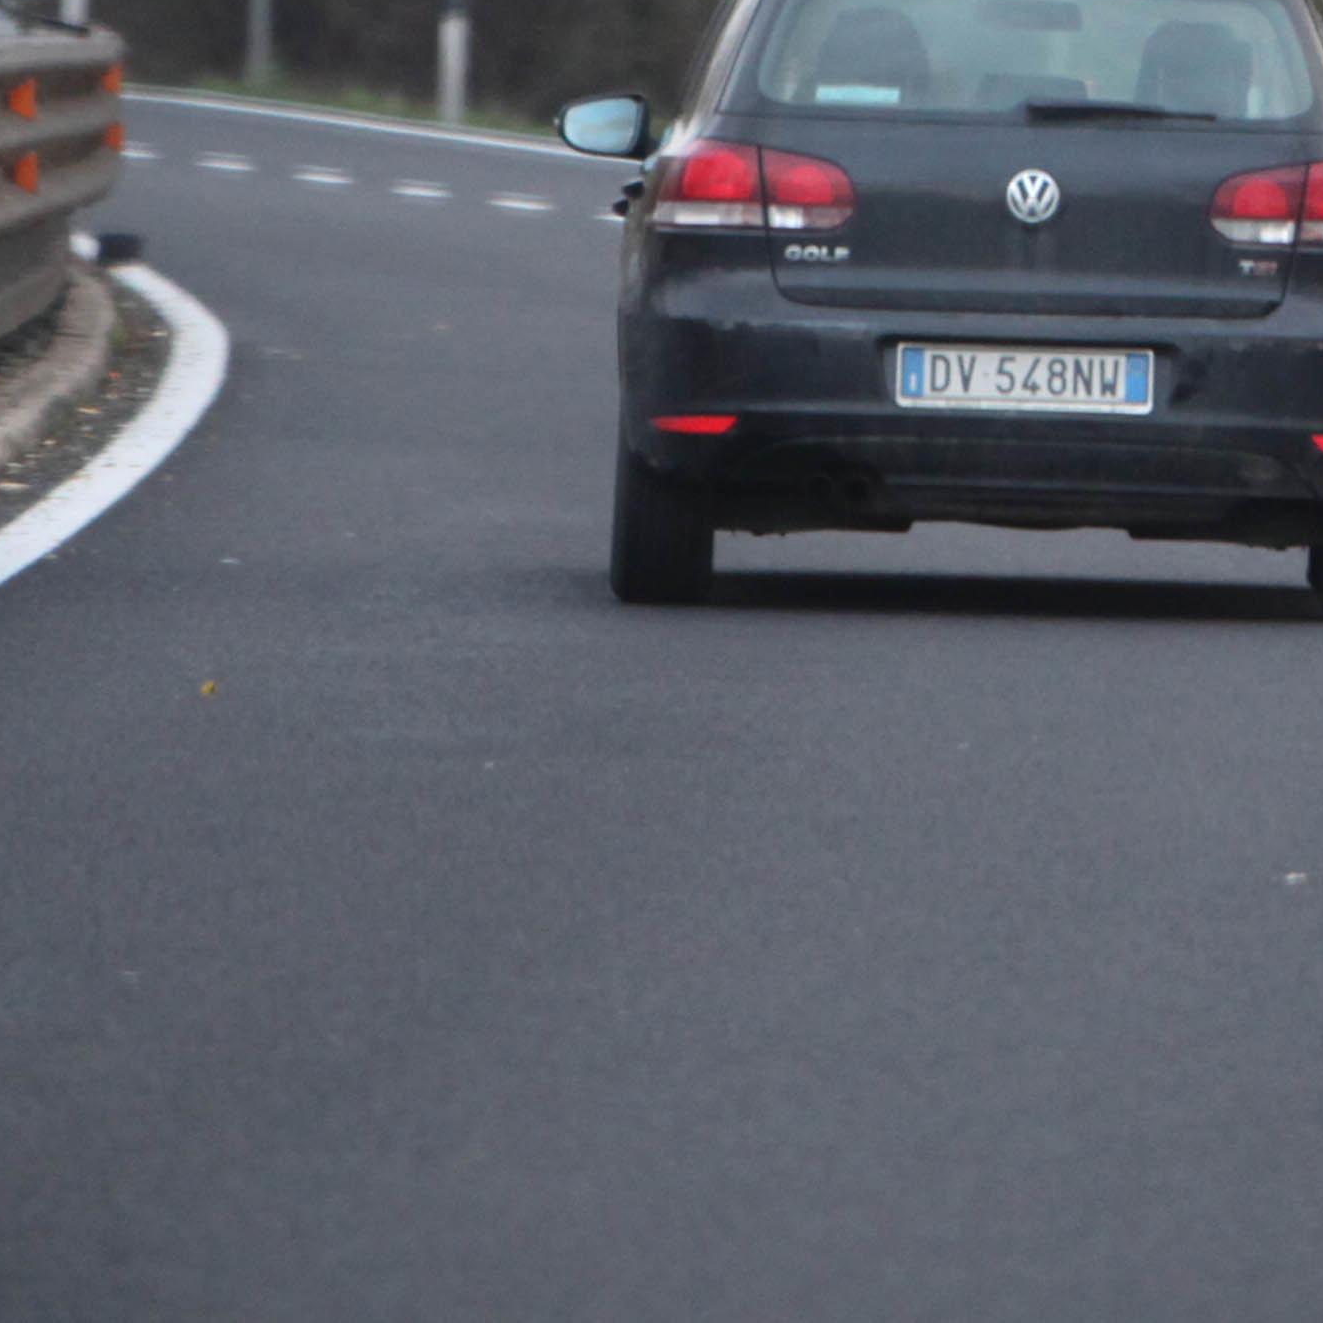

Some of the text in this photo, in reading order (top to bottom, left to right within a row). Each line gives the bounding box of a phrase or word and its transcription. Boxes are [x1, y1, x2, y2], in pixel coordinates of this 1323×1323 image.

[784, 244, 850, 261] GOLF
[929, 353, 1120, 398] DV 548NW
